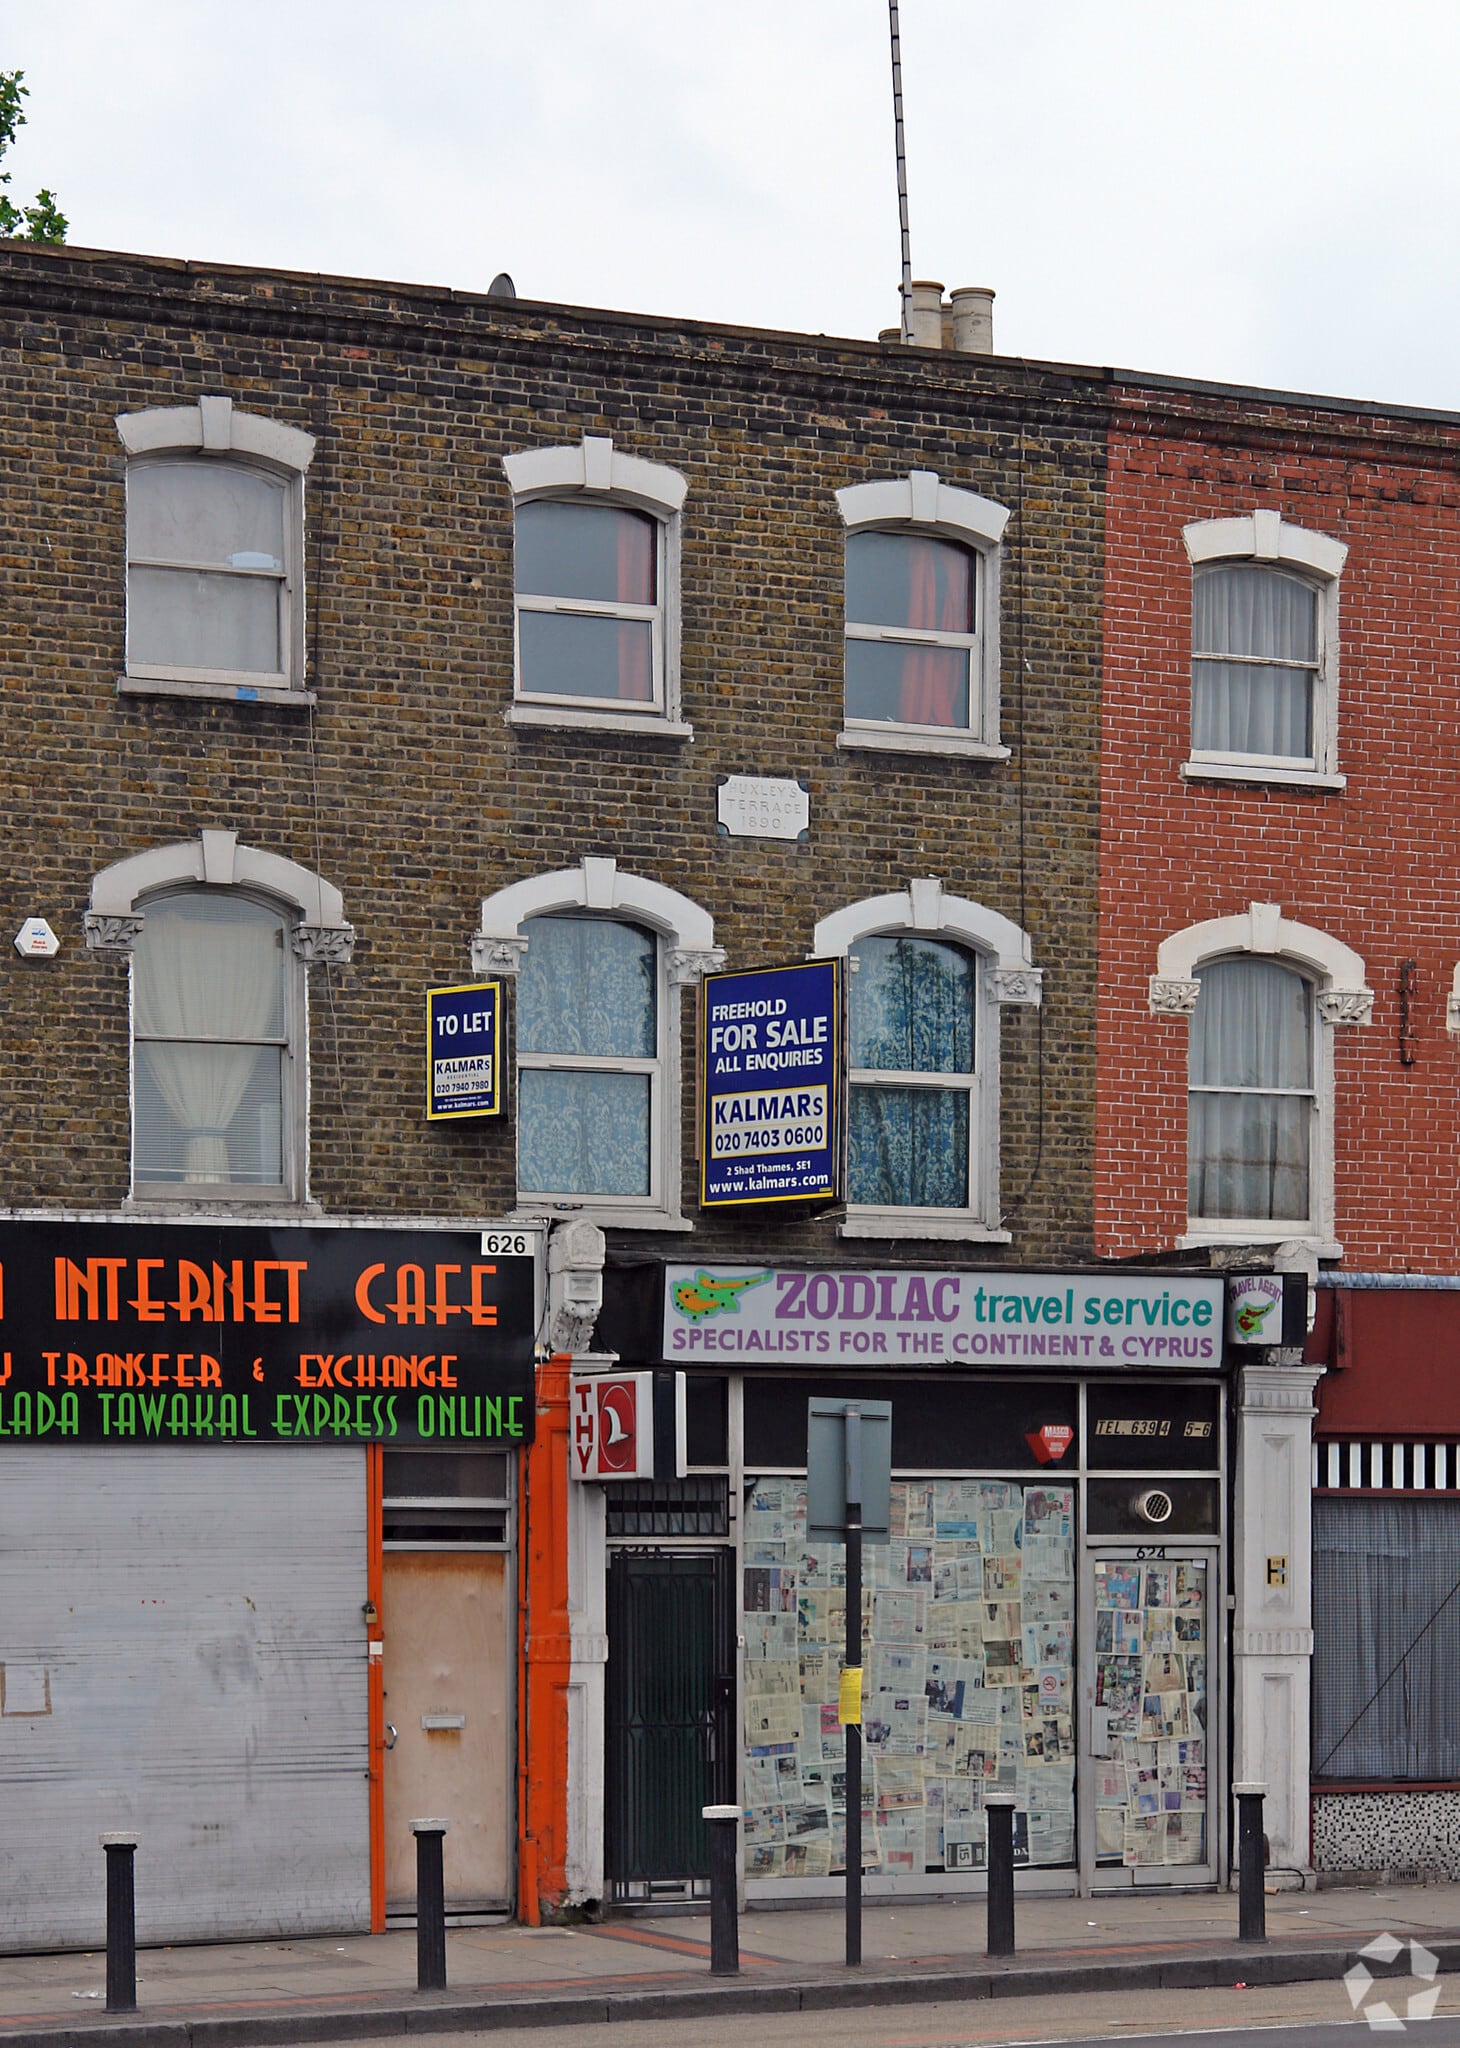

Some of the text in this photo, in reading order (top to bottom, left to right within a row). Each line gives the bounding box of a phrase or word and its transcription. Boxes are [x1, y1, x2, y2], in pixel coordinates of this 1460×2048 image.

[729, 783, 798, 798] HUXLEY'S
[726, 798, 801, 814] TERRACE
[712, 998, 787, 1022] FREEHOLD
[437, 1011, 492, 1036] TO LET
[711, 1016, 828, 1053] FOR SALE
[436, 1059, 490, 1074] KALMARS
[714, 1048, 823, 1074] ALL ENQUIRIES
[436, 1084, 450, 1093] 020
[715, 1094, 823, 1125] KALMARS
[715, 1125, 823, 1152] 020 7403 0600
[727, 1160, 811, 1176] 2 Shad Thames, SE1
[709, 1174, 828, 1193] www.kalmars.com
[487, 1234, 526, 1254] 626
[55, 1257, 307, 1323] INTERNET
[355, 1263, 497, 1327] CAFE
[775, 1273, 1212, 1326] ZODIAC travel service
[1258, 1278, 1282, 1303] AGENT
[672, 1328, 1213, 1358] SPECIALISTS FOR THE CONTINENT & CYPRUS
[42, 1352, 222, 1387] TRANSFER
[253, 1357, 264, 1382] &
[295, 1355, 457, 1388] EXCHANGE
[98, 1392, 257, 1436] TAWAKAL
[271, 1393, 397, 1437] EXPRESS
[417, 1395, 523, 1437] ONLINE
[575, 1384, 593, 1473] THY
[1098, 1421, 1125, 1434] TEL.
[1136, 1547, 1166, 1559] 624
